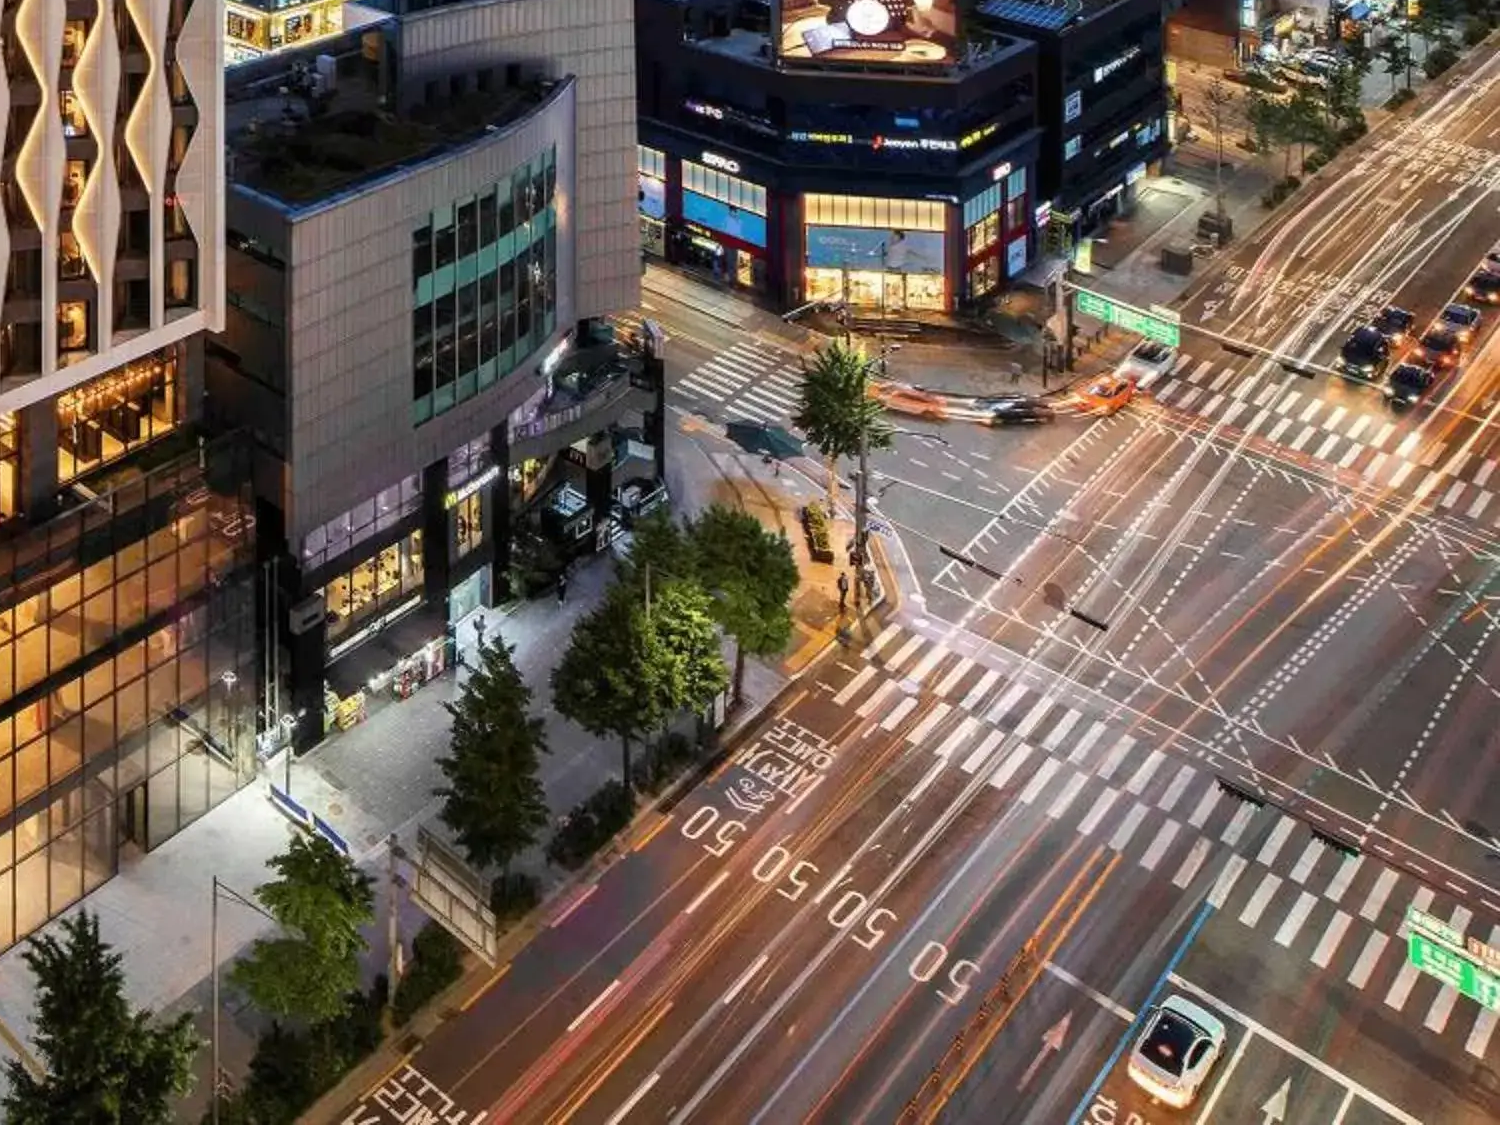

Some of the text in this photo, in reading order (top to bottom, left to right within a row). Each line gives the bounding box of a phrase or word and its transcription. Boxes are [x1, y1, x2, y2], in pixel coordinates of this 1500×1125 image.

[681, 806, 747, 857] 50
[752, 845, 820, 902] 50
[827, 890, 898, 950] 50
[908, 941, 981, 1005] 50
